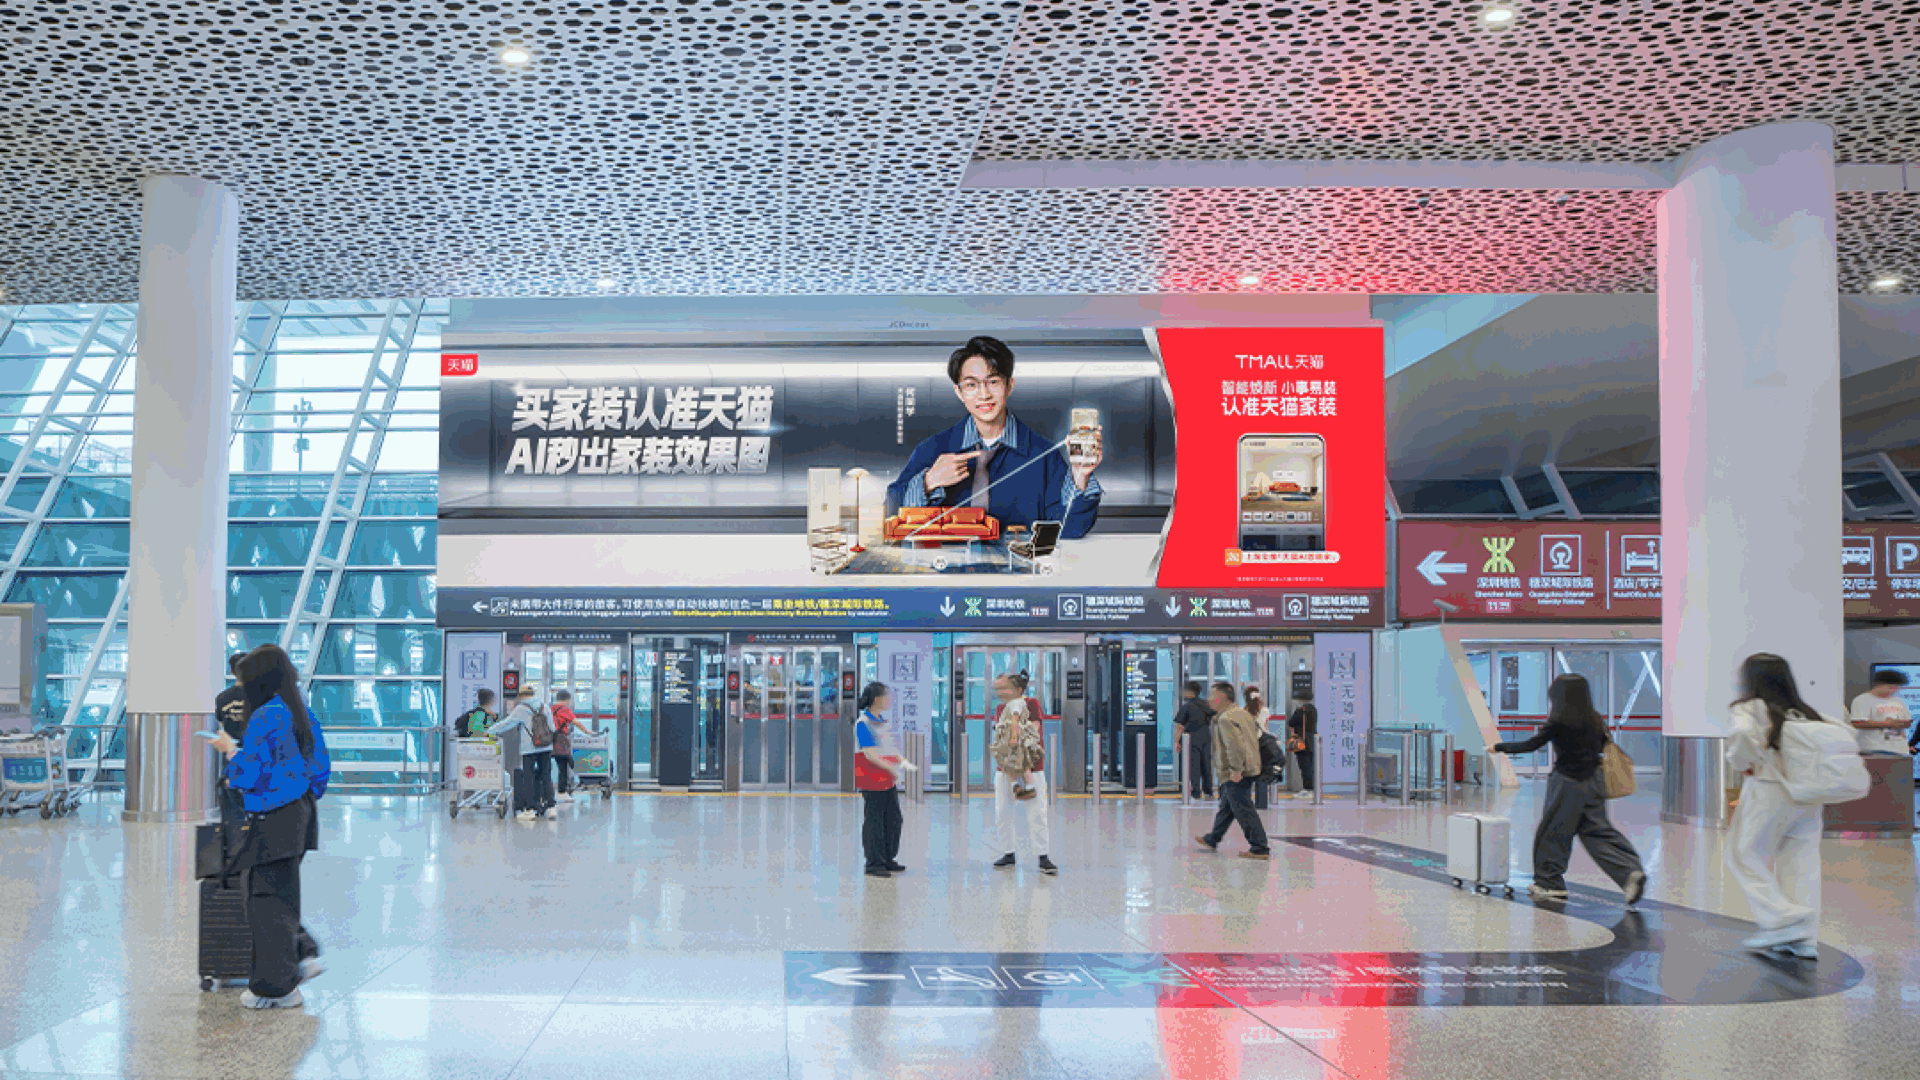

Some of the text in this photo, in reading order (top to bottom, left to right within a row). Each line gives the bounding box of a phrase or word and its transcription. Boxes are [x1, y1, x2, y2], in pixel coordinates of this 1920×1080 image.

[447, 358, 474, 372] 天猫
[511, 386, 774, 430] 买家装认准天猫
[1221, 396, 1338, 417] 认准天猫家装
[504, 437, 771, 475] AI秒出家装效果图
[1477, 577, 1521, 588] 深圳地铁
